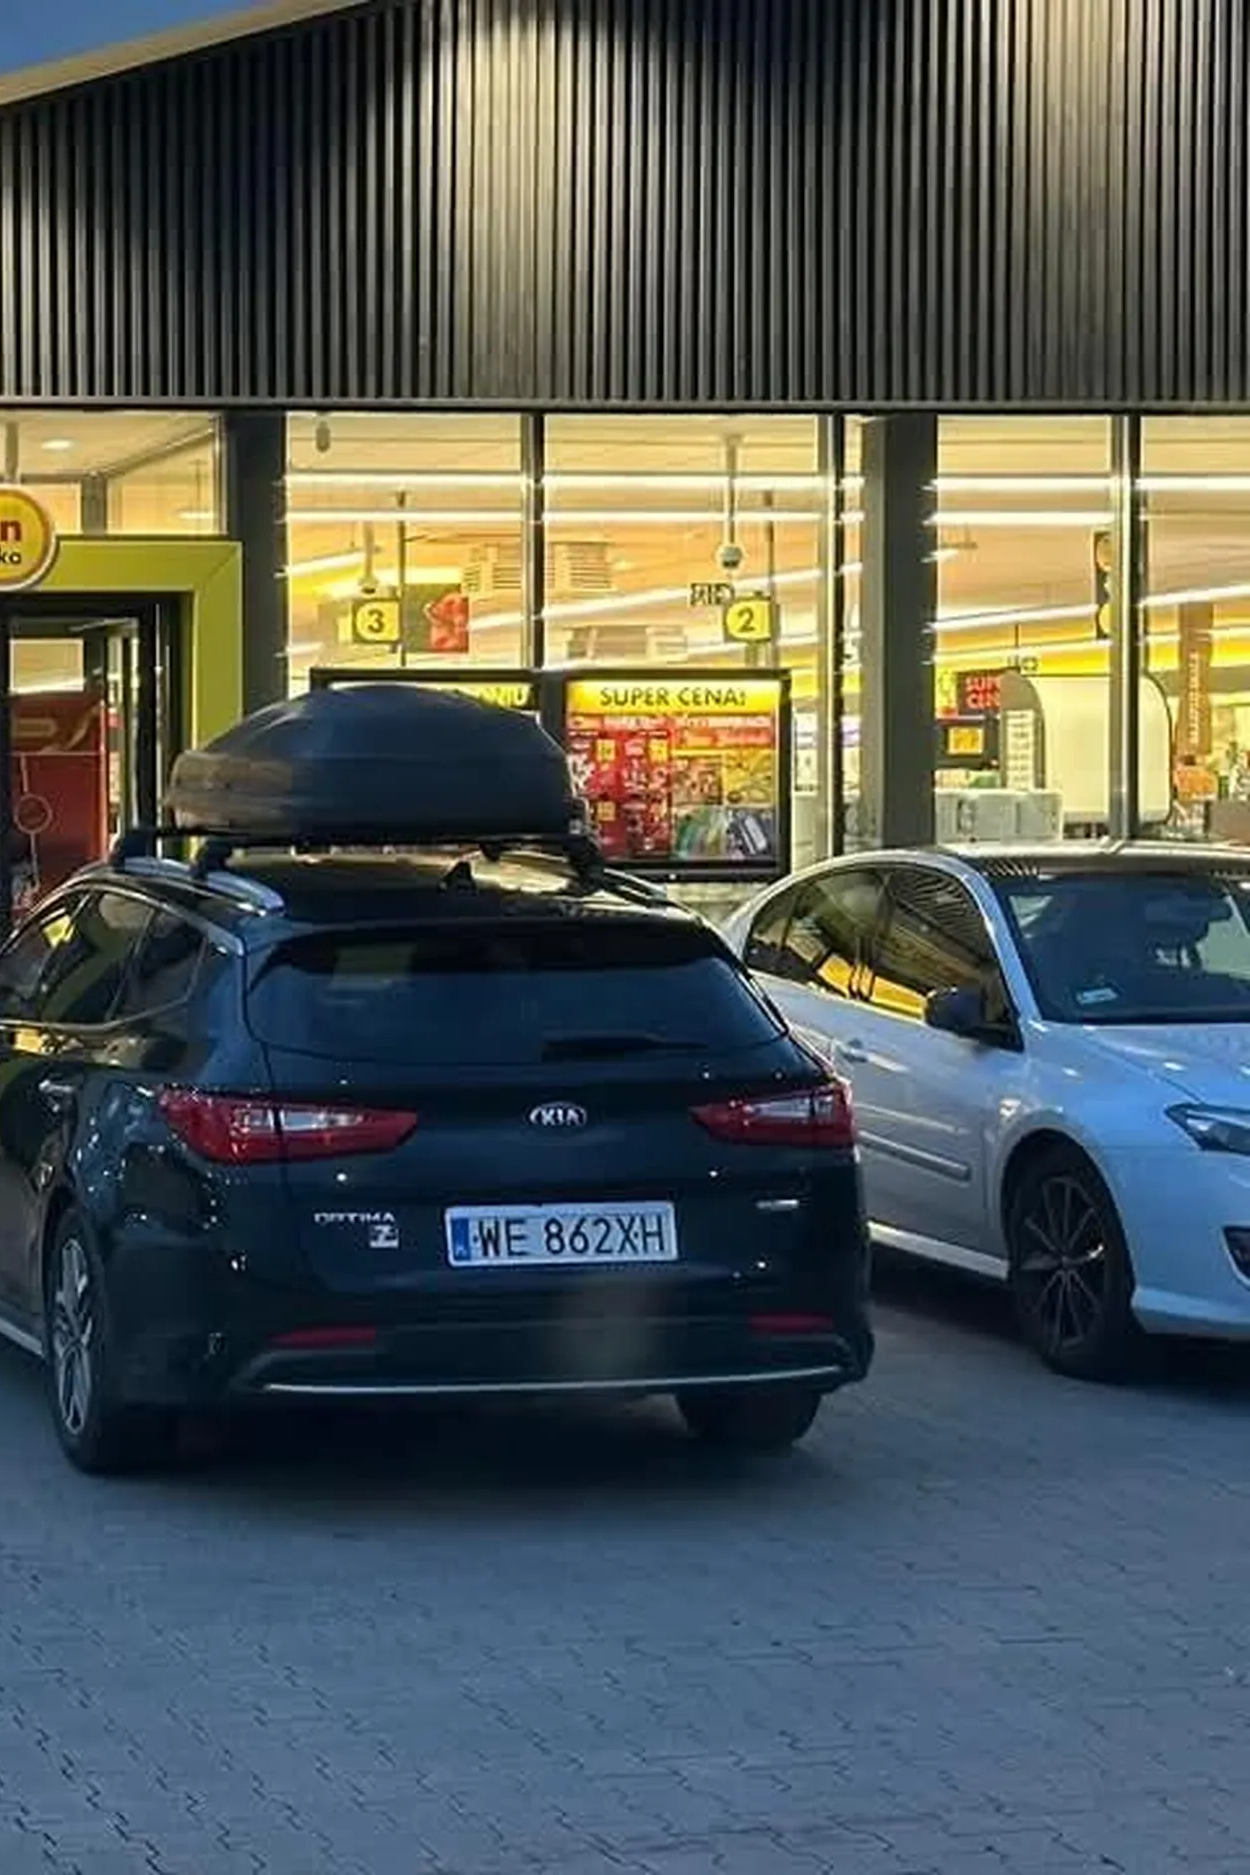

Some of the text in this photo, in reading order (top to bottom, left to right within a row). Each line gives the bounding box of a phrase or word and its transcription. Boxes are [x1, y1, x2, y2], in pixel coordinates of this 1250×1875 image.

[367, 608, 384, 634] 3
[737, 607, 756, 633] 2
[599, 686, 670, 706] SUPER
[538, 1106, 583, 1127] KIA
[478, 1213, 666, 1257] WE 862XH
